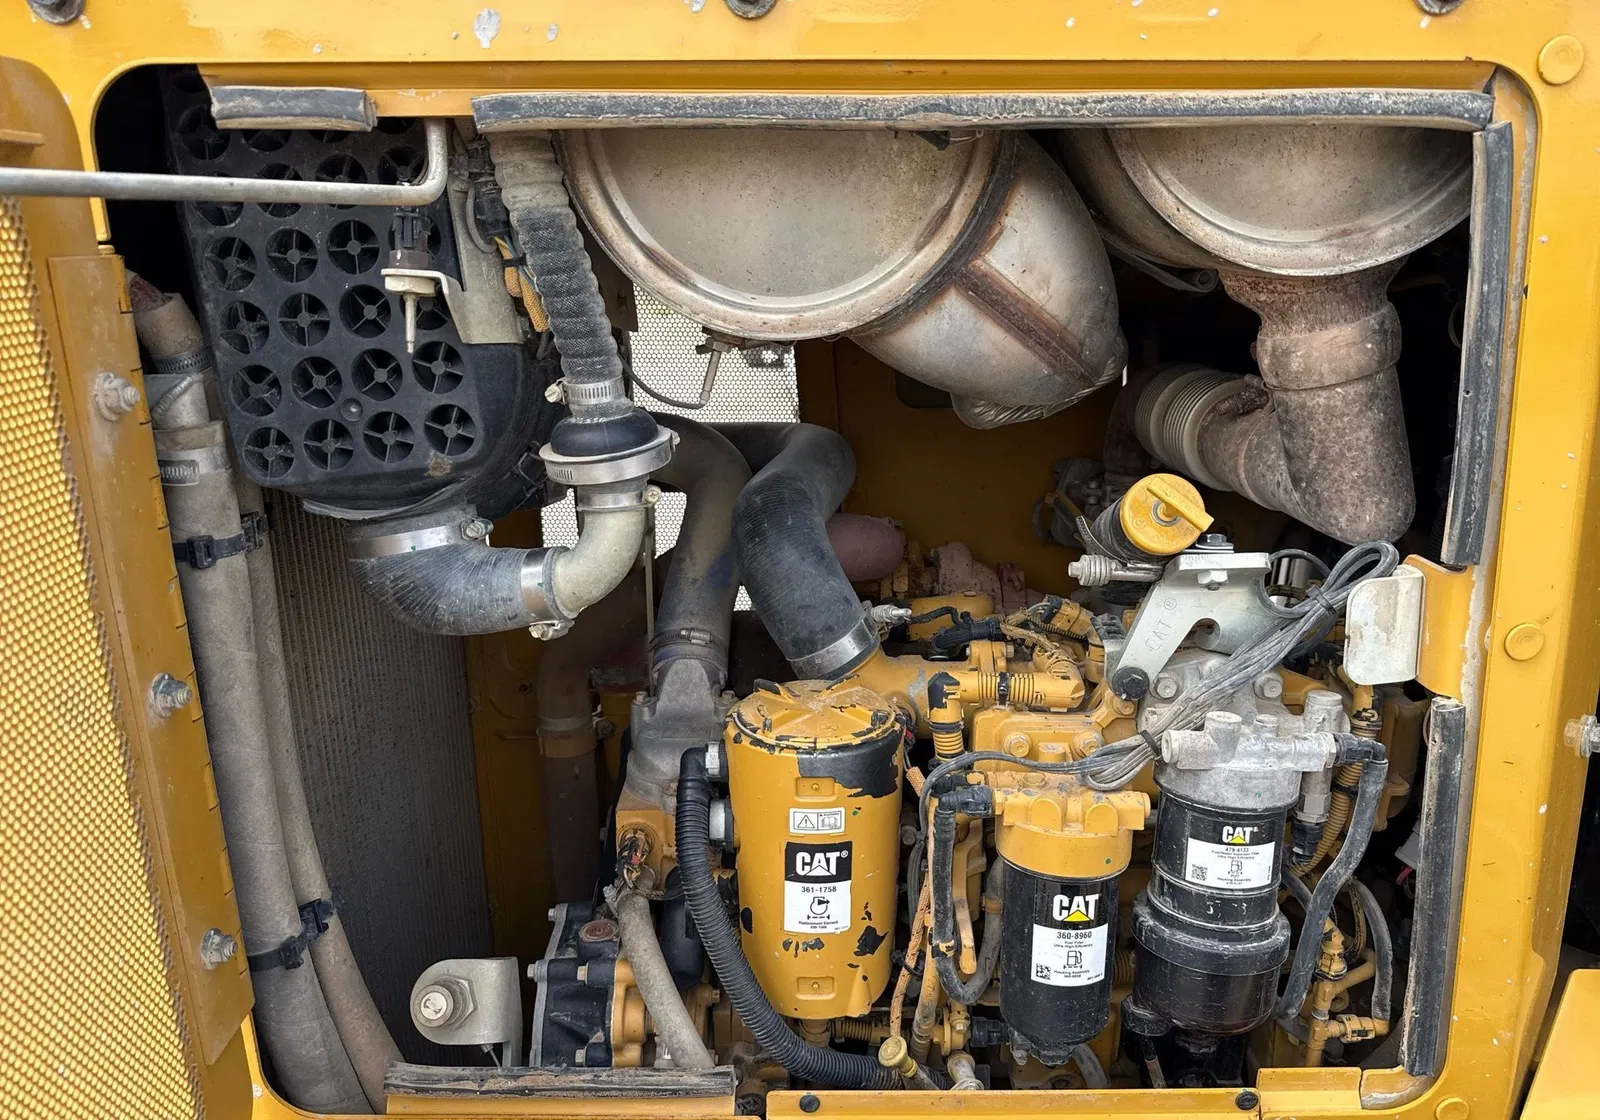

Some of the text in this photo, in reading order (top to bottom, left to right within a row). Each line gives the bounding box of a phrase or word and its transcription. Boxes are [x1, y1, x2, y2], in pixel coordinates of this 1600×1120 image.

[801, 885, 837, 893] 361-1758
[1052, 893, 1099, 922] CAT
[1056, 931, 1093, 940] 360-8960
